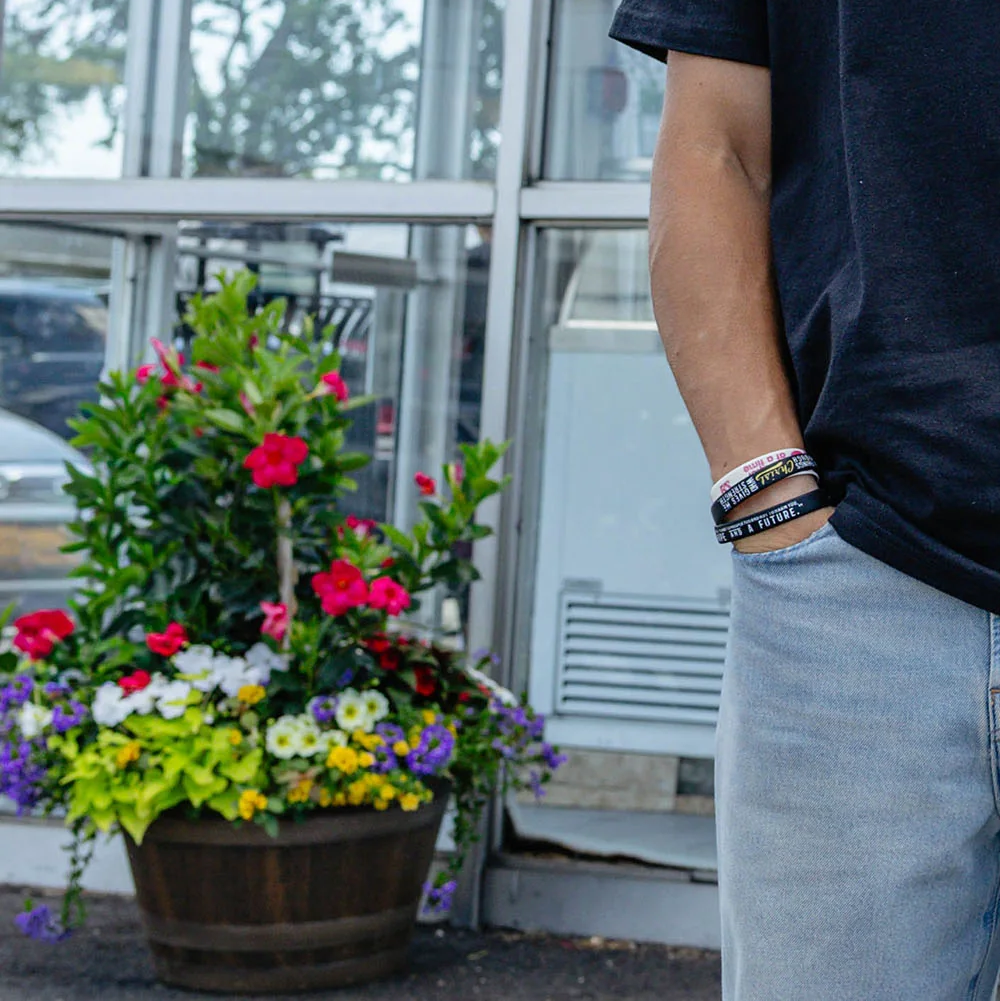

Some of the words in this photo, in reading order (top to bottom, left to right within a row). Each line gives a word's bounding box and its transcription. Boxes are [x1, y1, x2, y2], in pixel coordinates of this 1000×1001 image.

[755, 459, 794, 486] Christ
[731, 489, 750, 506] GIVES
[747, 524, 755, 534] A
[758, 507, 801, 530] FUTURE.
